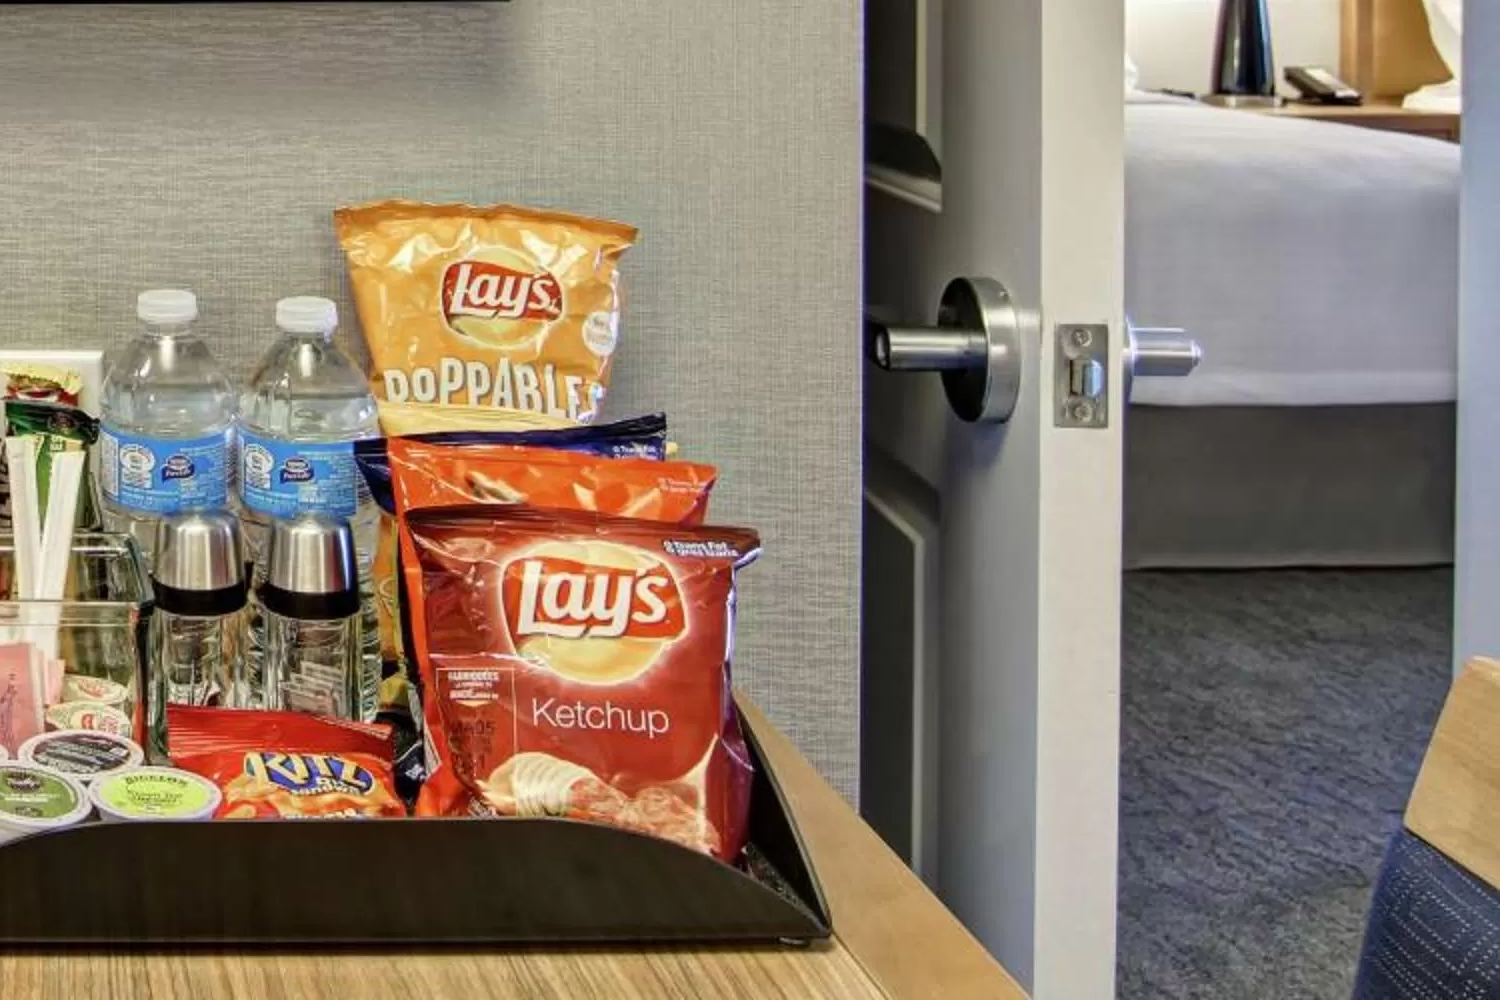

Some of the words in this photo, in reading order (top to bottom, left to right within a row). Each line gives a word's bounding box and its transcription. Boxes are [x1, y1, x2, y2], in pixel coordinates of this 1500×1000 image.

[450, 263, 555, 319] Lay's
[516, 560, 669, 638] Lay's
[531, 697, 670, 739] Ketchup
